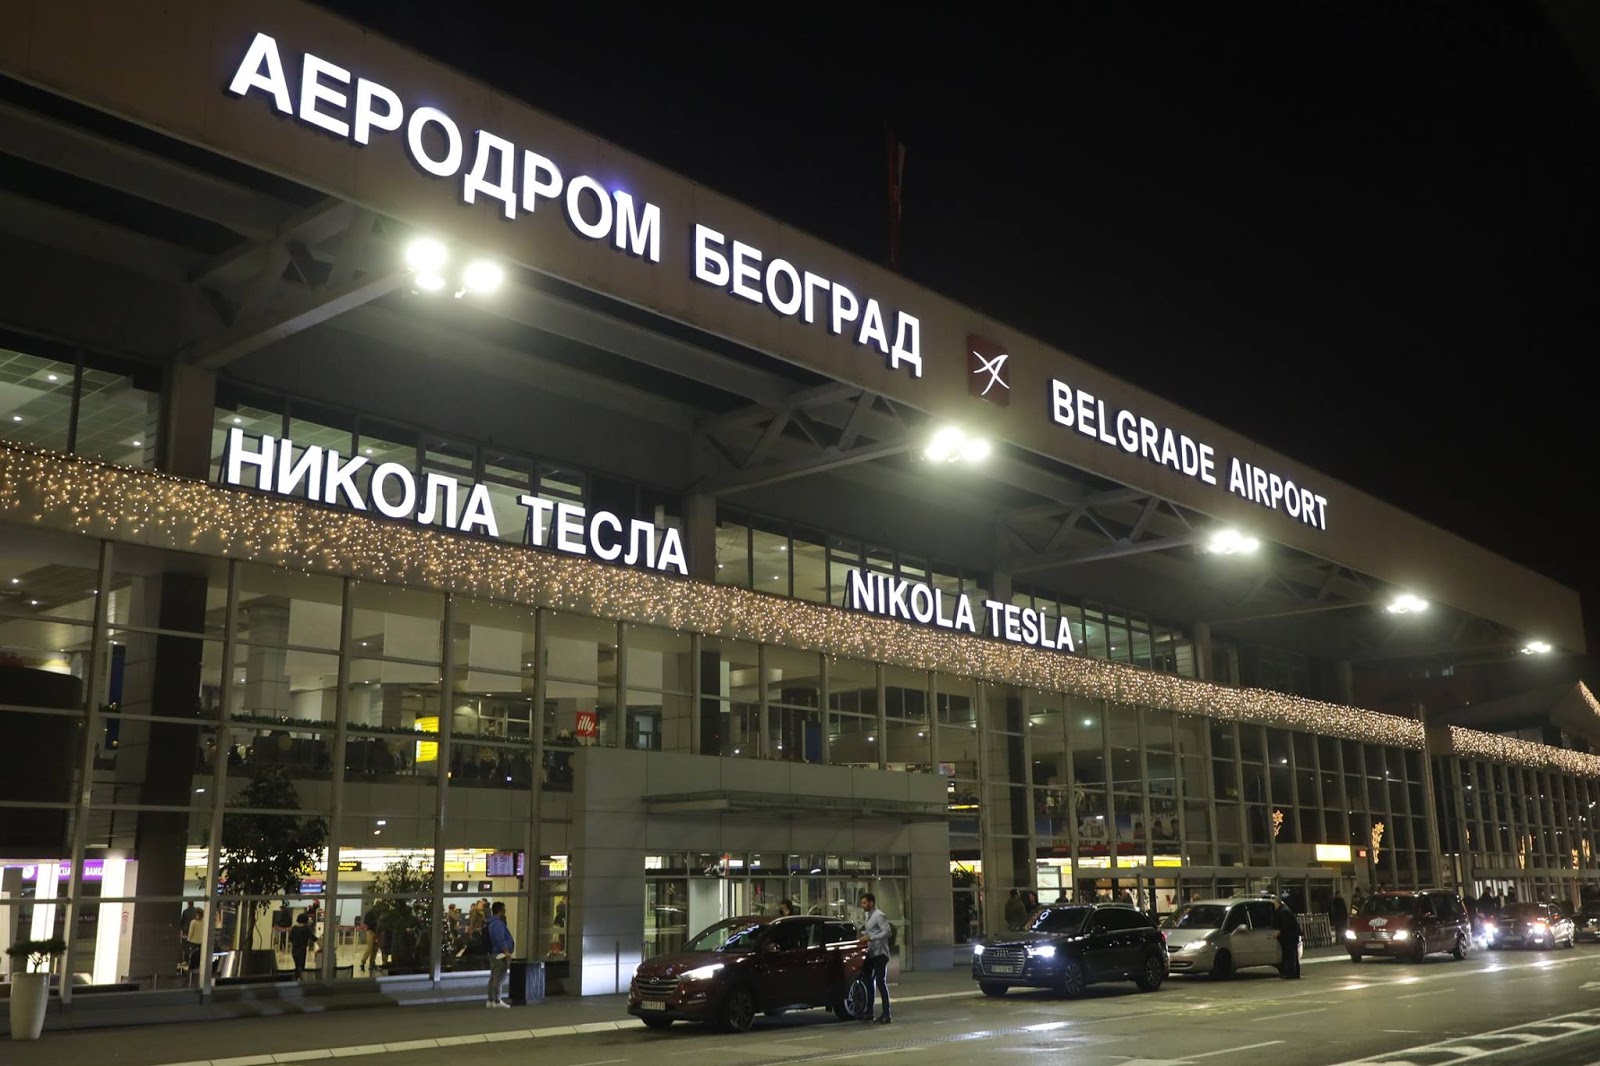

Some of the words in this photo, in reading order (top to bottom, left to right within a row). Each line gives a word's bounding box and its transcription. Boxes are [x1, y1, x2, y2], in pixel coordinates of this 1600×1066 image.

[228, 31, 663, 263] АЕРОДРОМ
[693, 223, 923, 379] БЕОГРАД
[225, 427, 499, 538] НИКОЛА
[520, 494, 688, 576] ТЕСЛА
[1052, 379, 1217, 485] BELGRADE
[1229, 457, 1328, 530] AIRPORT
[851, 569, 976, 633] NIKOLA
[985, 599, 1076, 652] TESLA
[578, 715, 595, 734] illy
